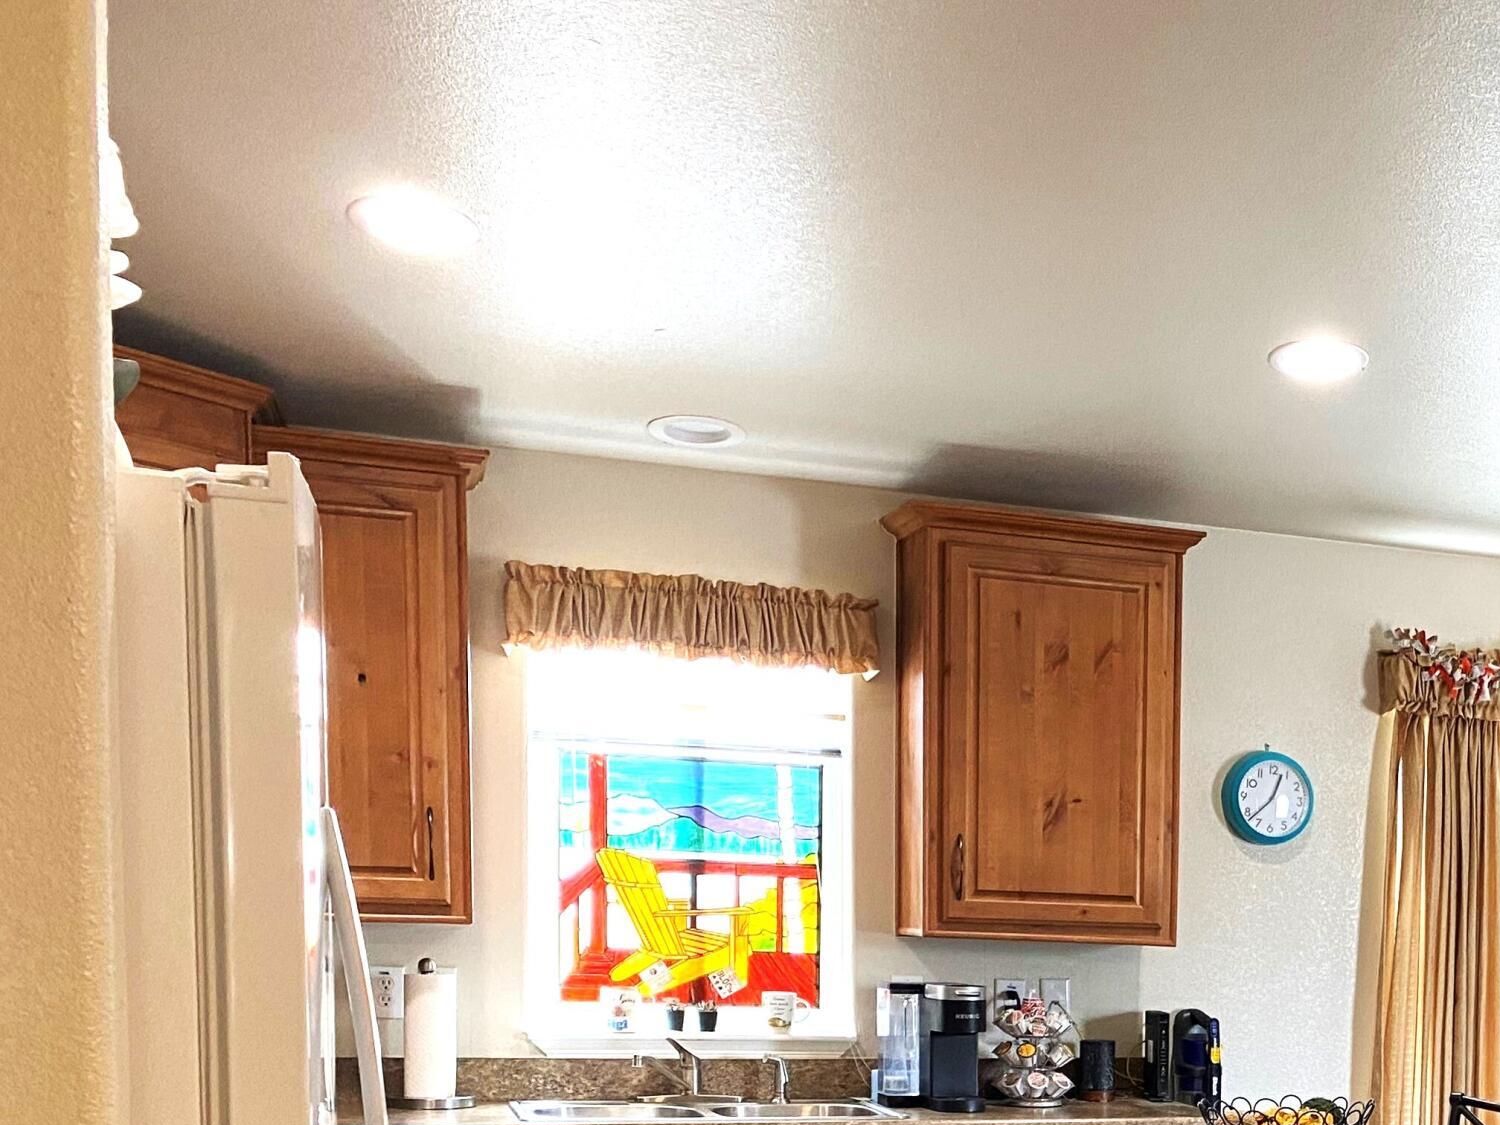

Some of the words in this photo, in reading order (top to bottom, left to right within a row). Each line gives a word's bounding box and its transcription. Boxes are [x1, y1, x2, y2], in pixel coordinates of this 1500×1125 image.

[1269, 764, 1279, 775] 12
[1246, 778, 1258, 788] 10
[1293, 782, 1300, 792] 2
[1240, 791, 1247, 801] 9
[1296, 797, 1303, 807] 3
[1244, 807, 1251, 817] 8
[1291, 812, 1298, 821] 4
[1255, 818, 1262, 828] 7
[1281, 821, 1288, 831] 5
[1266, 824, 1273, 833] 6
